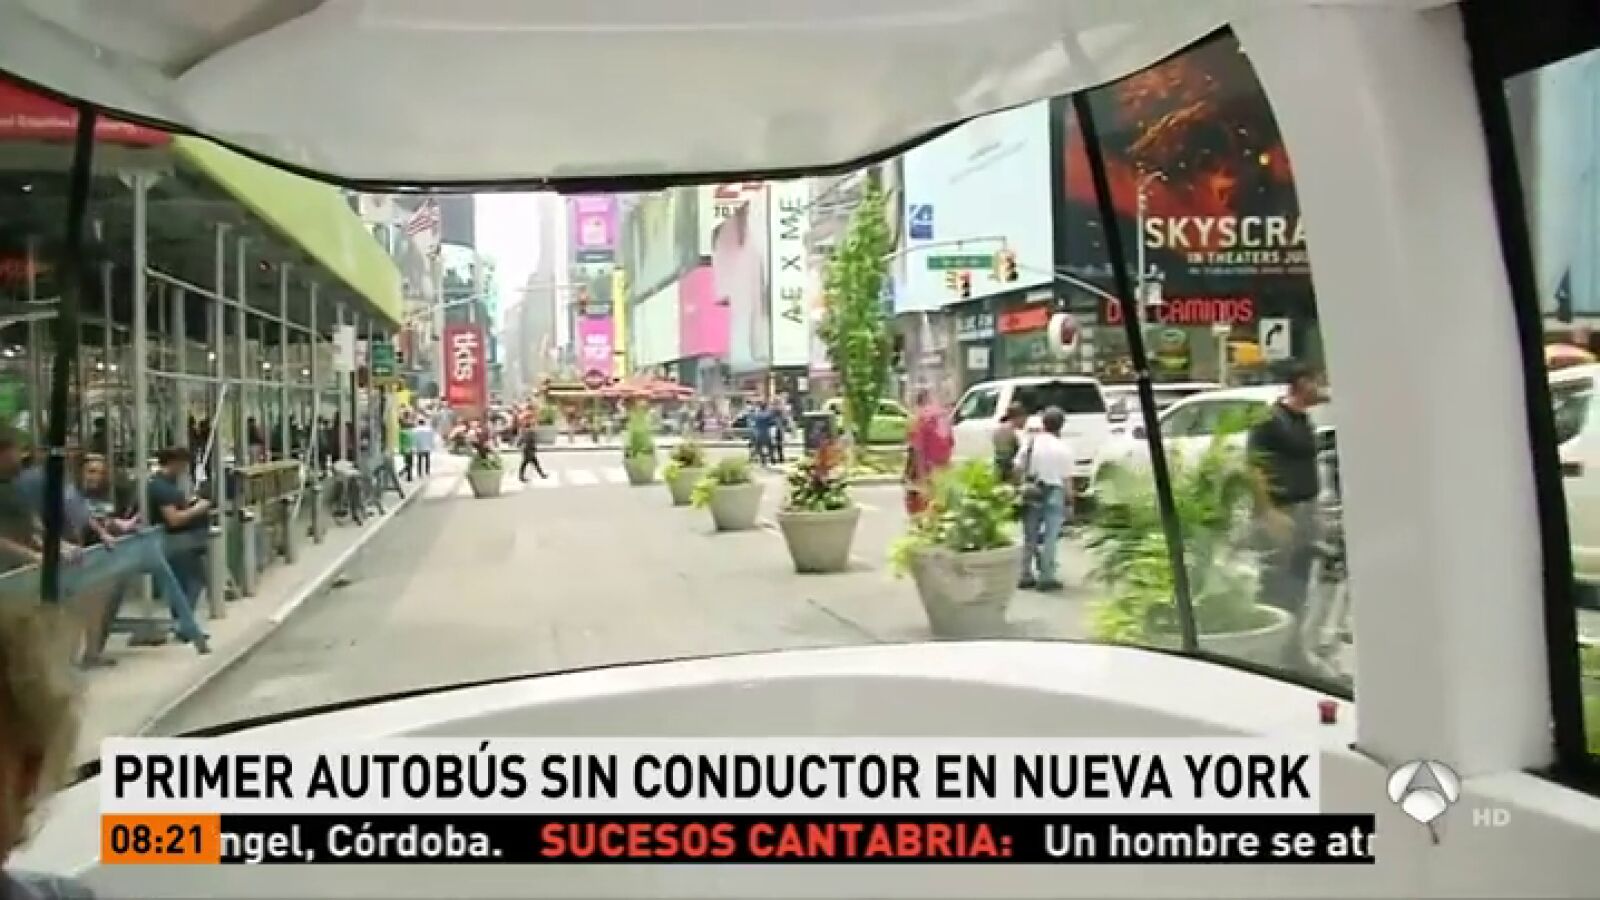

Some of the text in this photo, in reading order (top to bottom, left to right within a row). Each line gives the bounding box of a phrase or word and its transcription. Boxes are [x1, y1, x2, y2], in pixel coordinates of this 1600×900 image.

[779, 197, 803, 324] AE X ME
[1207, 251, 1280, 264] THEATERS
